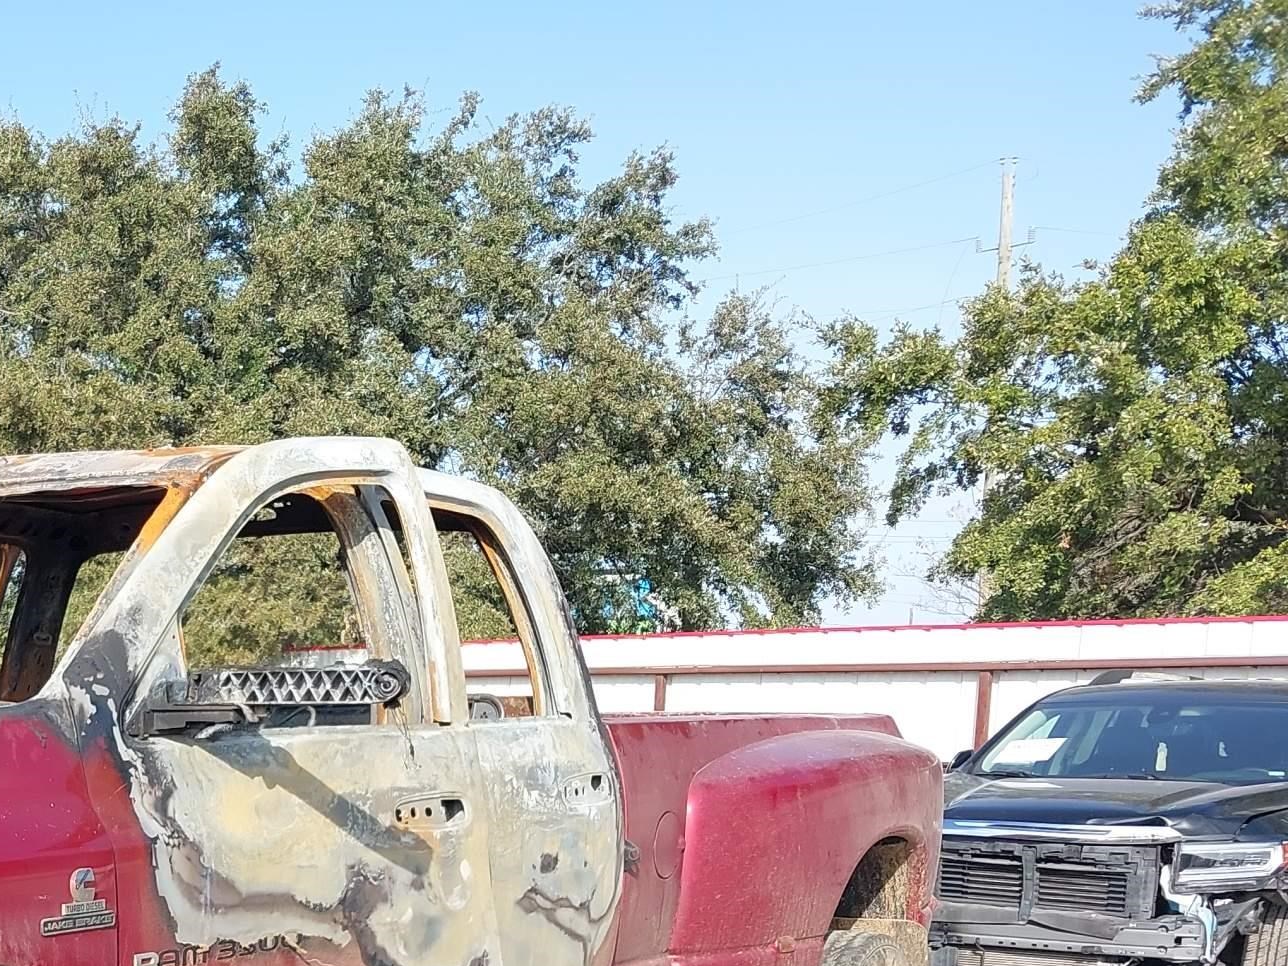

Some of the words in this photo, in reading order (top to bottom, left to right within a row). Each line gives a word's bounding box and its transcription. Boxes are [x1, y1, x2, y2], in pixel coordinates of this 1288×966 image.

[65, 903, 85, 914] TURBO
[86, 900, 105, 912] DIESEL
[44, 919, 74, 932] JAKE
[75, 914, 113, 928] BRAKE
